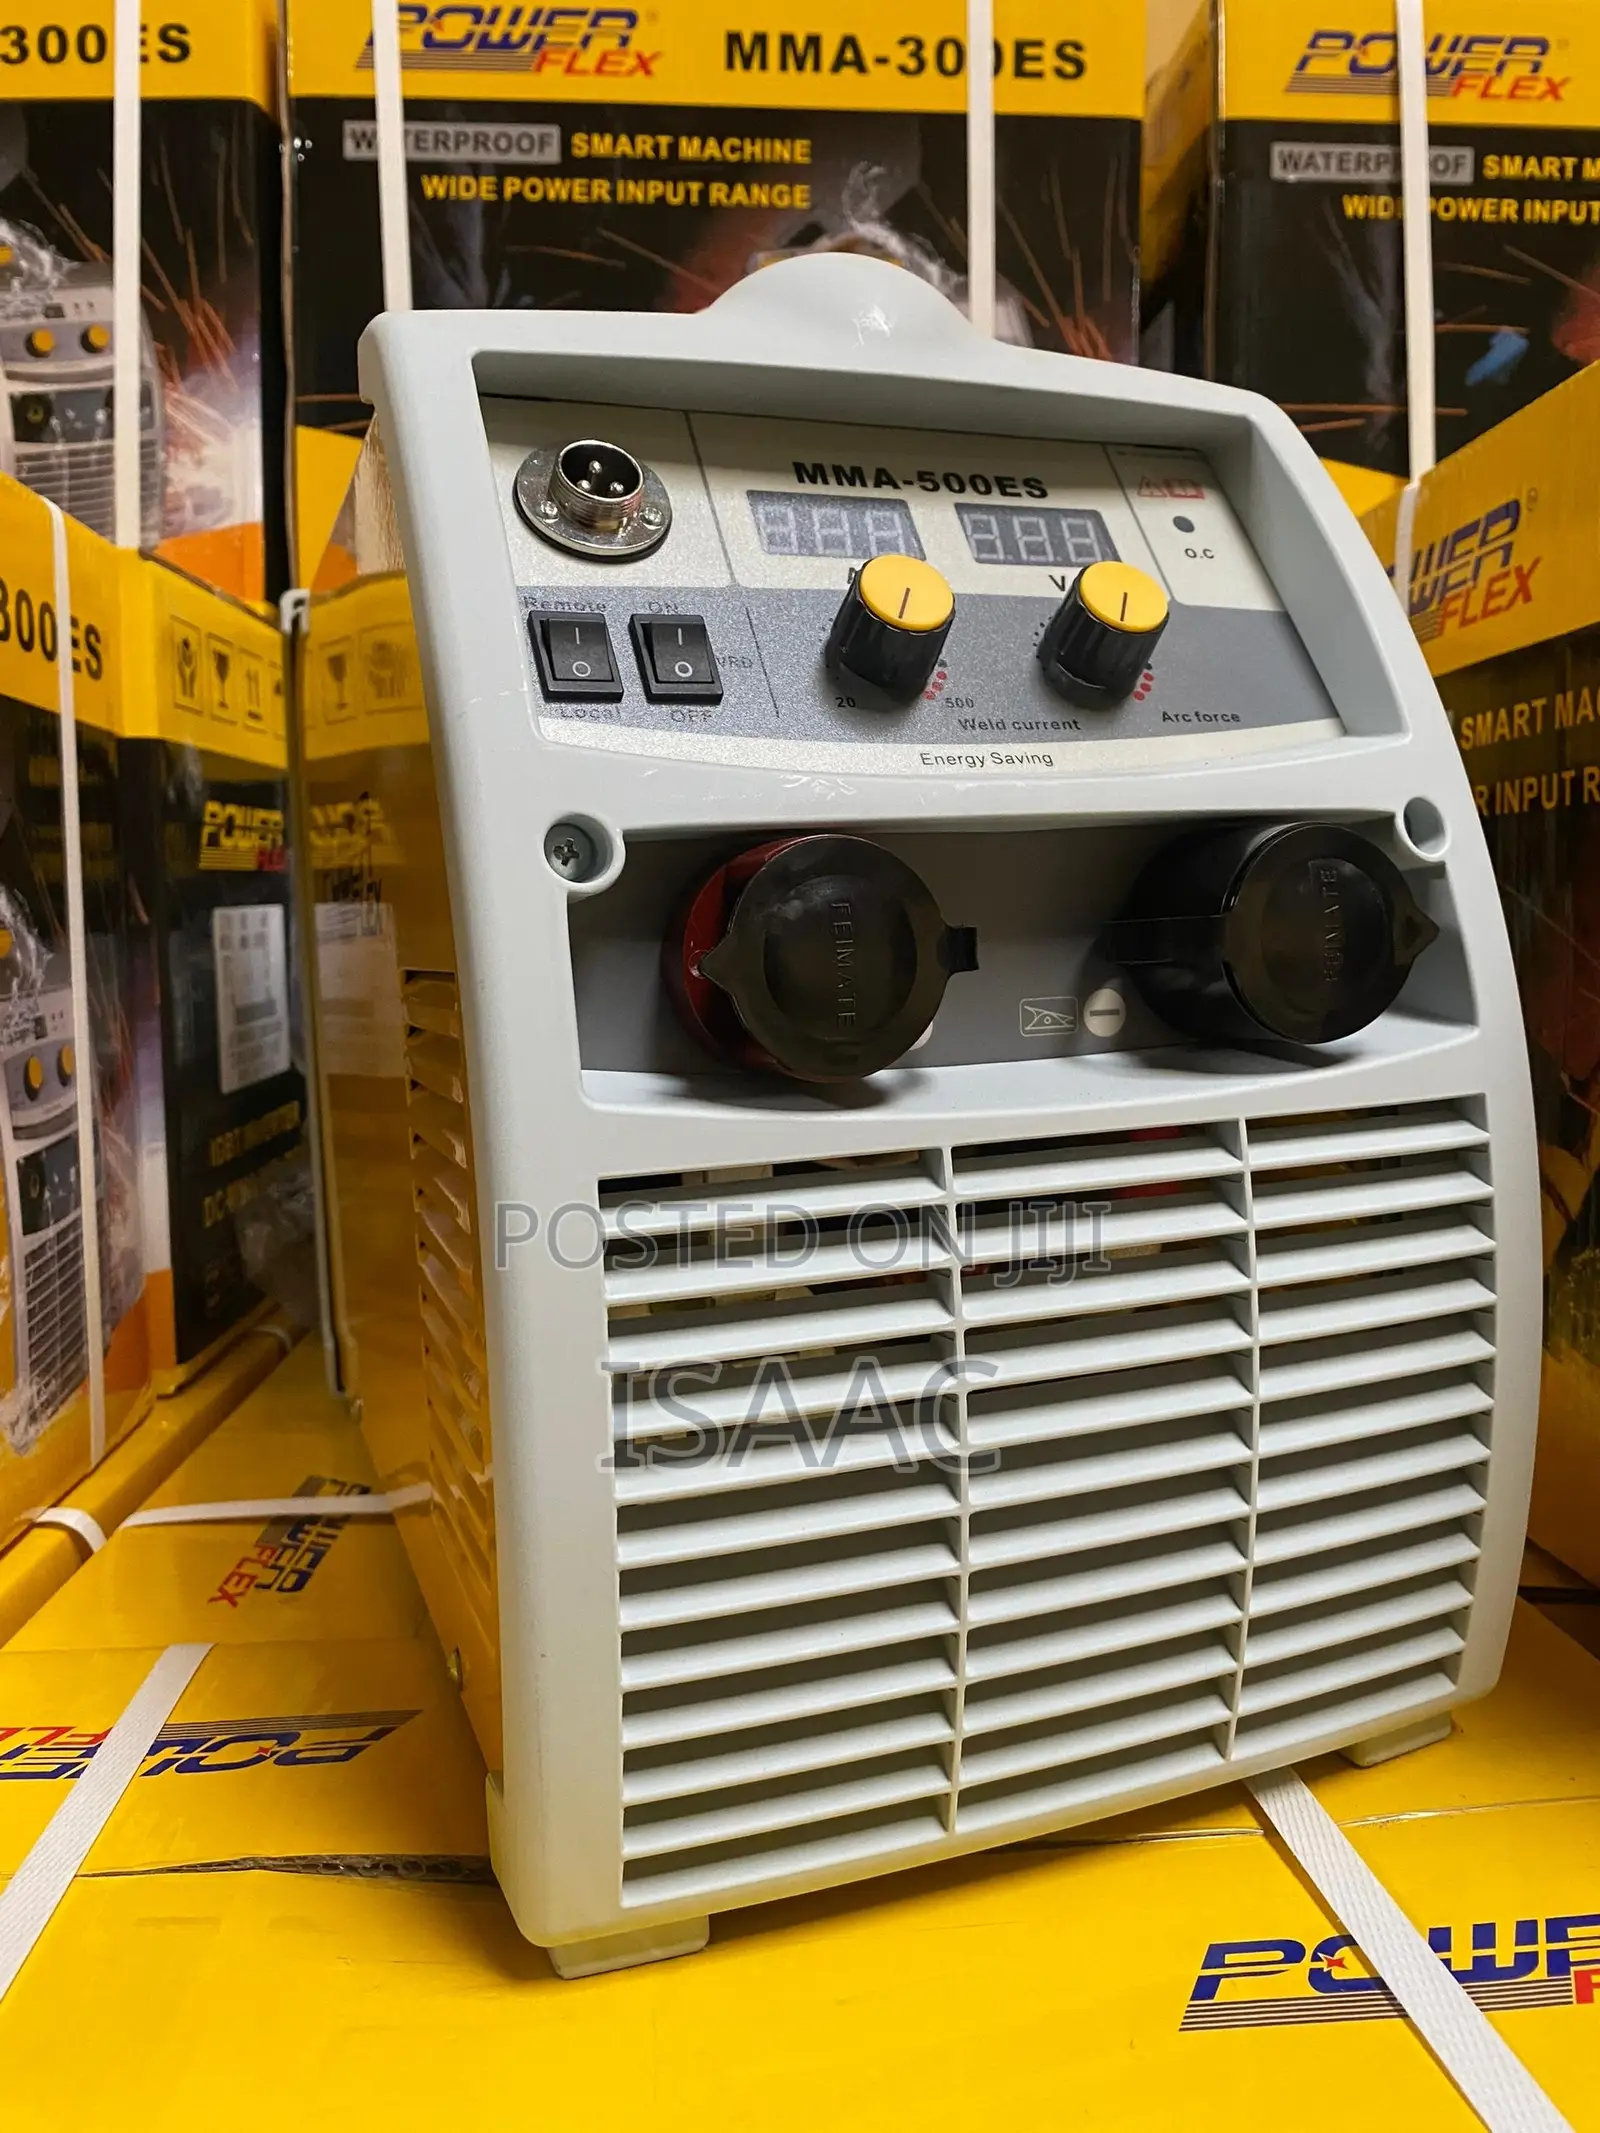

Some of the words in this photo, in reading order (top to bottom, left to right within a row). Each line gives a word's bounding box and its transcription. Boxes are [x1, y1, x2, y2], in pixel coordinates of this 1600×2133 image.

[531, 45, 664, 77] FLEX
[1451, 74, 1573, 101] FLEX
[350, 127, 554, 156] WTERPROOF
[571, 132, 674, 161] SMART
[679, 134, 812, 165] MACHINE
[1277, 148, 1468, 176] WATERPOF
[1482, 154, 1578, 181] SMART
[421, 174, 498, 202] WIDE
[503, 176, 611, 204] POWER
[616, 180, 703, 206] INPUT
[709, 182, 812, 210] RANGE
[1342, 194, 1403, 220] WID
[793, 461, 1049, 500] MMA-500ES
[1184, 547, 1216, 560] O.C
[523, 596, 607, 612] Remote
[648, 599, 680, 614] ON
[1438, 555, 1542, 637] FLEX
[559, 706, 622, 720] Local
[835, 696, 856, 709] 20
[944, 696, 975, 709] 500
[670, 709, 713, 723] OFF
[957, 717, 1007, 732] Weld
[1011, 717, 1082, 732] current
[1161, 710, 1193, 724] Arc
[1195, 710, 1242, 724] force
[1459, 697, 1548, 750] SMART
[1554, 685, 1600, 730] MA
[919, 751, 986, 768] Energy
[989, 750, 1055, 767] Saving
[1494, 769, 1576, 816] INPUT
[831, 902, 857, 1029] FEIMATE
[206, 1540, 280, 1608] FLEX
